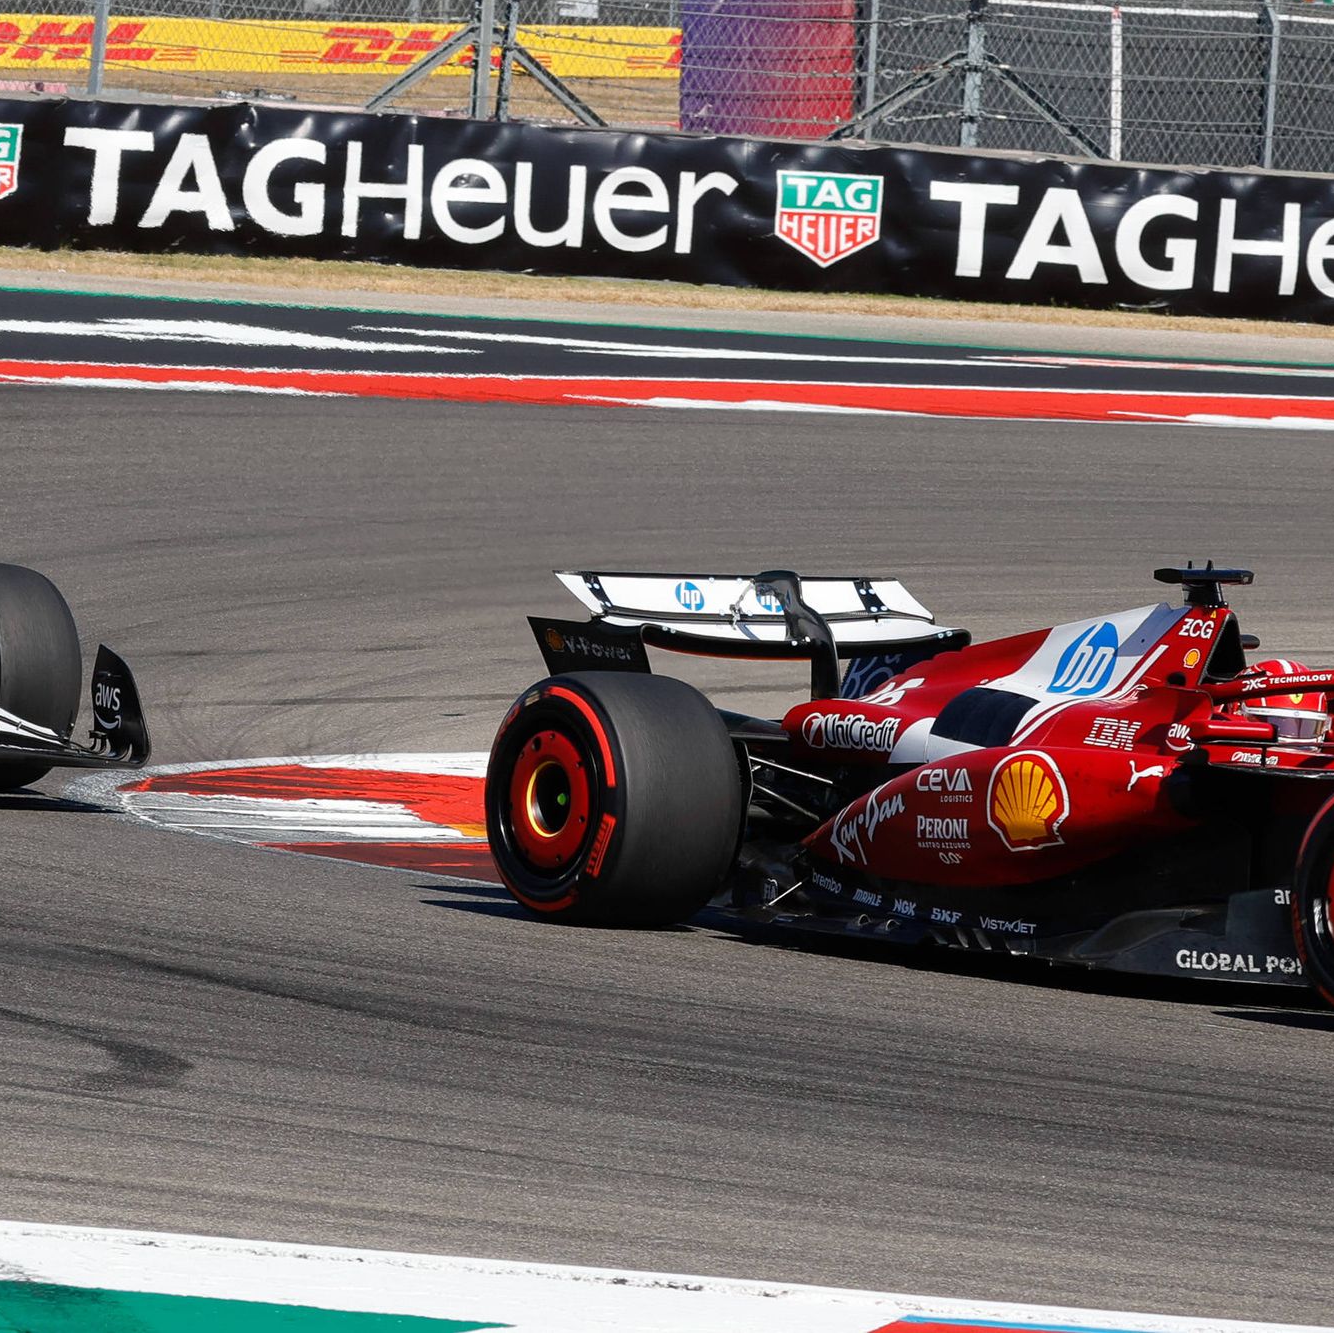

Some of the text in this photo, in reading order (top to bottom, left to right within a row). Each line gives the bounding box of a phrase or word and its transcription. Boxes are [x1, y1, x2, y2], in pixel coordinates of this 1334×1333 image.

[786, 175, 875, 211] TAG
[781, 213, 875, 256] HEUER
[677, 582, 704, 611] hp
[1178, 618, 1215, 639] ZCG
[1047, 621, 1118, 697] hp
[1269, 673, 1333, 685] TECHNOLOGY
[95, 683, 121, 711] aws
[822, 713, 902, 751] UniCredit
[1083, 717, 1141, 751] IBM
[940, 795, 973, 803] LOGISTICS
[917, 815, 968, 839] PERONI
[812, 867, 842, 894] brembo
[852, 888, 883, 907] MAHLE
[893, 898, 917, 917] NGK
[931, 907, 962, 924] SKF
[1176, 948, 1261, 974] GLOBAL
